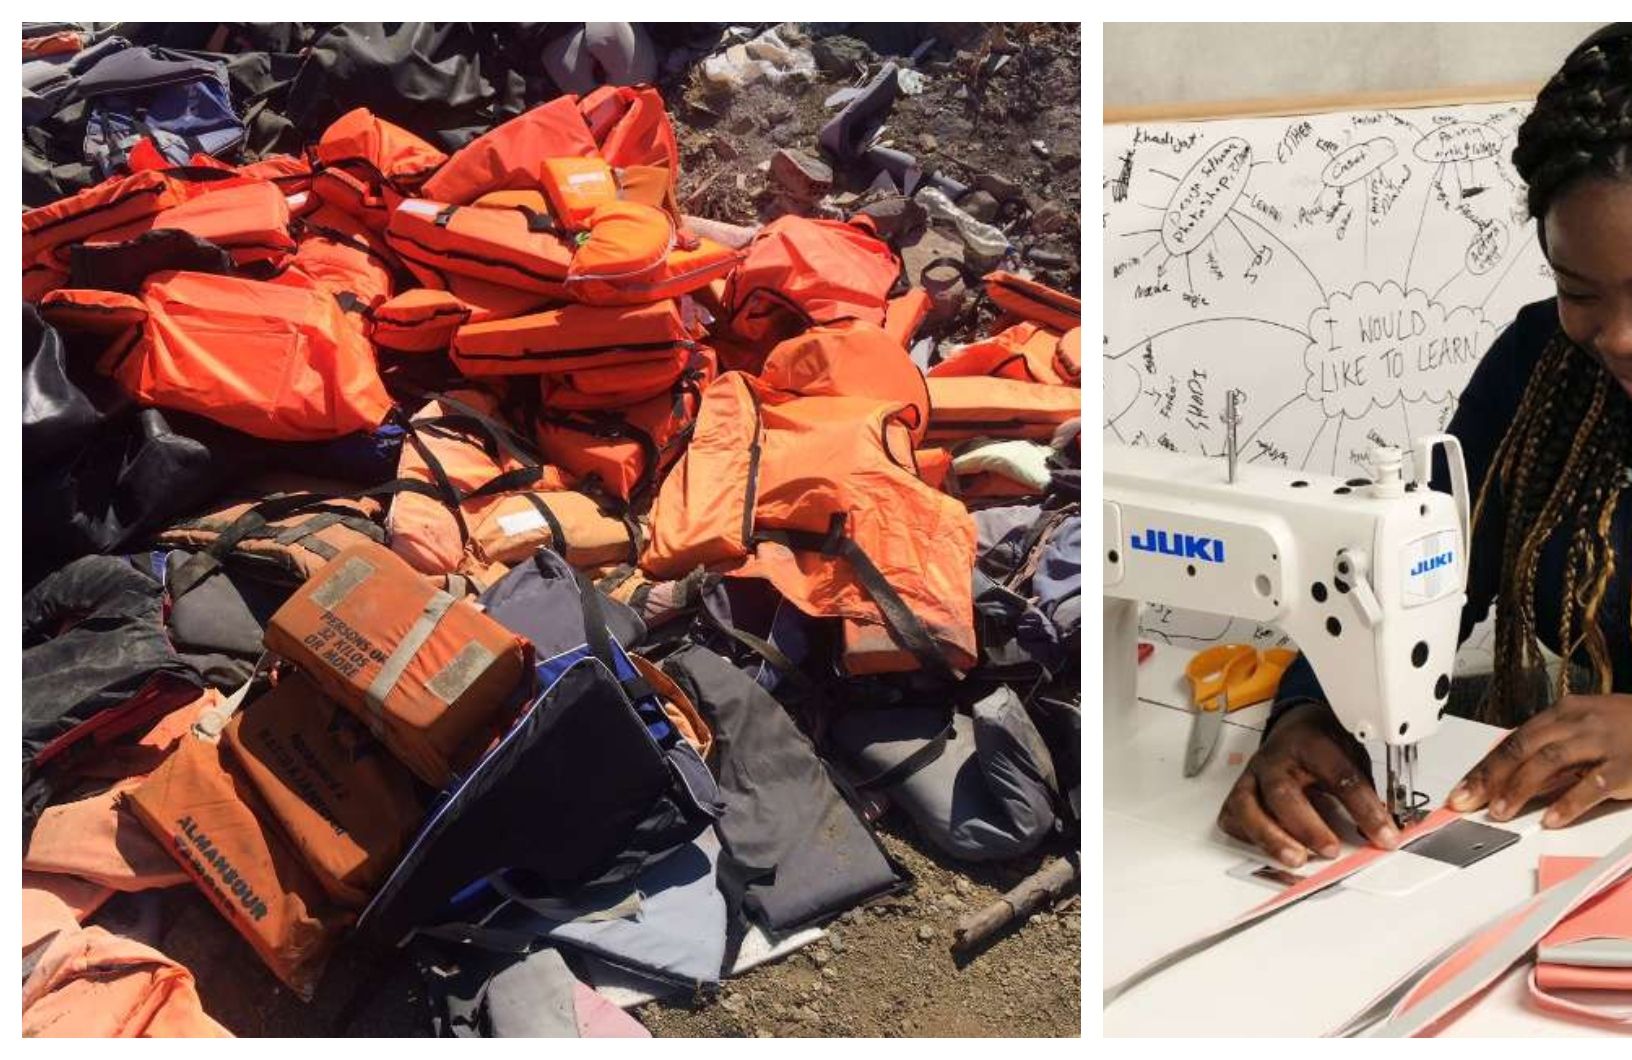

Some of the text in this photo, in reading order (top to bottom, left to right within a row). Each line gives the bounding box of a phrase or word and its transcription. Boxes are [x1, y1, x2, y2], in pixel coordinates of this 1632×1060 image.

[1324, 310, 1426, 351] I WOULD
[1322, 332, 1479, 393] LIKE TO LEARN
[1131, 529, 1224, 563] JUKI
[1411, 551, 1453, 576] JUKI
[320, 611, 370, 652] PERSONS
[304, 634, 359, 677] OR MORE
[333, 639, 369, 667] KILOS
